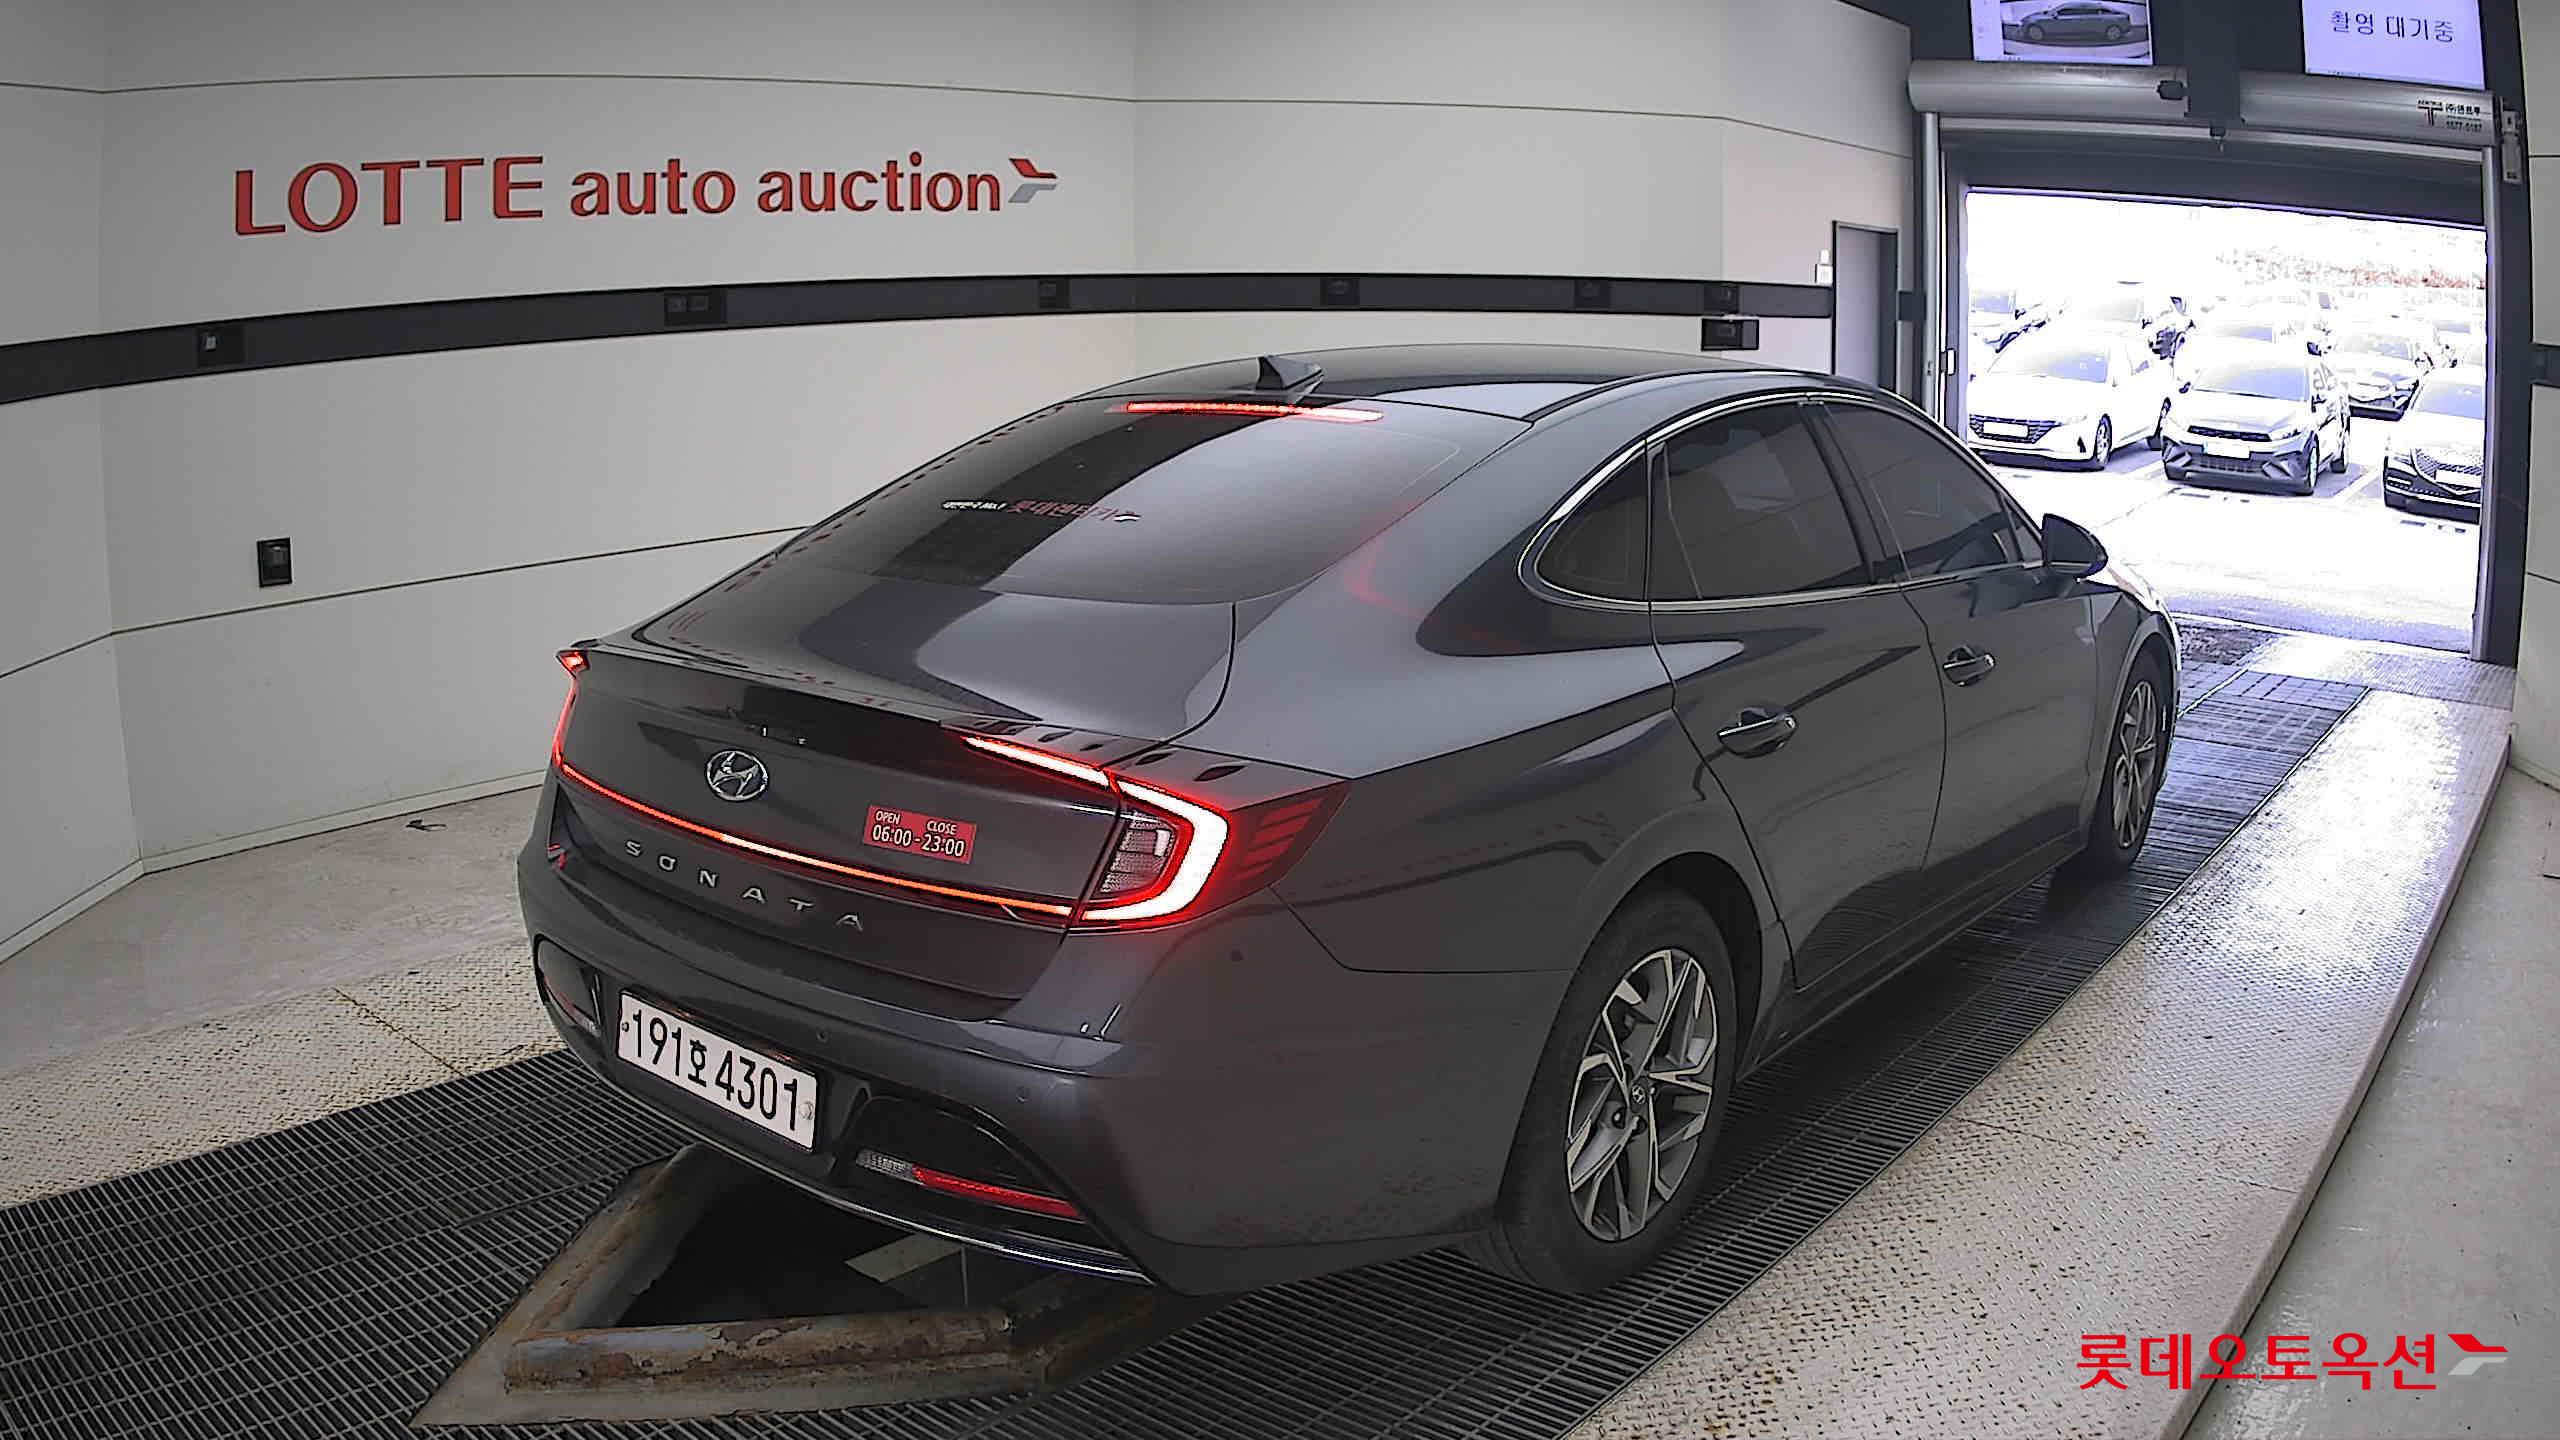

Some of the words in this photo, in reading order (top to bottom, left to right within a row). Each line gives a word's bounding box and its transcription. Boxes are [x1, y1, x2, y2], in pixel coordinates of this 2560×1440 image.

[2385, 15, 2454, 43] 대기중
[235, 155, 544, 236] LOTTE
[569, 158, 736, 217] auto
[757, 151, 1001, 214] auction
[875, 810, 901, 825] OPEN
[926, 820, 958, 835] CLOSE
[626, 840, 865, 933] SONATA
